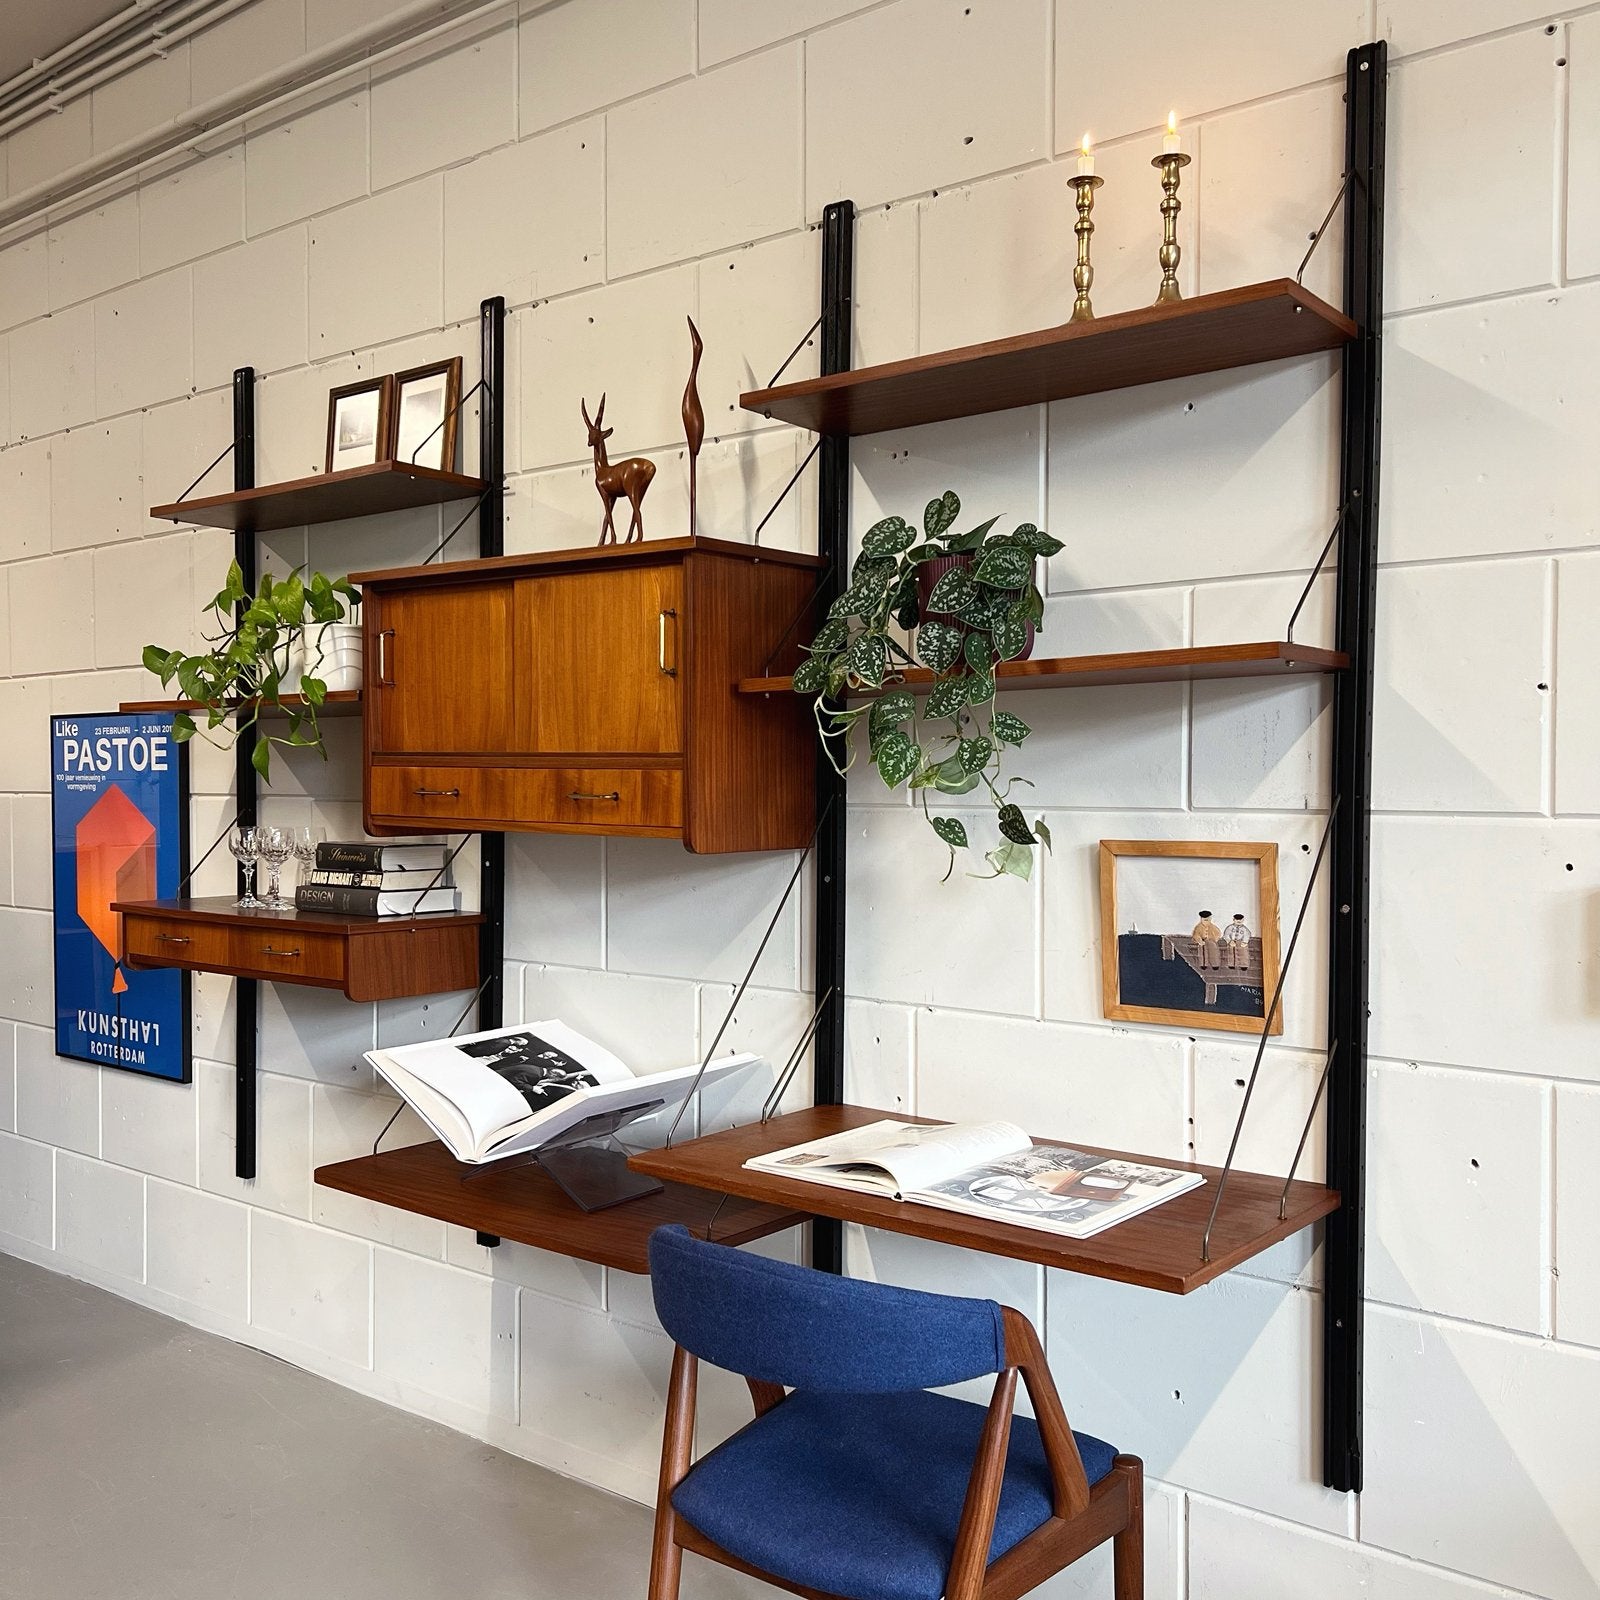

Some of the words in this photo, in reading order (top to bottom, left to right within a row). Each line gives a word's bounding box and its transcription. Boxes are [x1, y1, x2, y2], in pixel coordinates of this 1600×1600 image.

[55, 720, 79, 737] Like
[95, 727, 102, 735] 23
[102, 726, 131, 735] FEBRUARI
[142, 725, 146, 734] 2
[147, 725, 161, 734] JUNI
[161, 724, 173, 733] 201
[63, 736, 168, 772] PASTOE
[311, 871, 329, 884] HANS
[300, 889, 334, 903] DESIGN
[90, 1040, 146, 1065] ROTTERDAM
